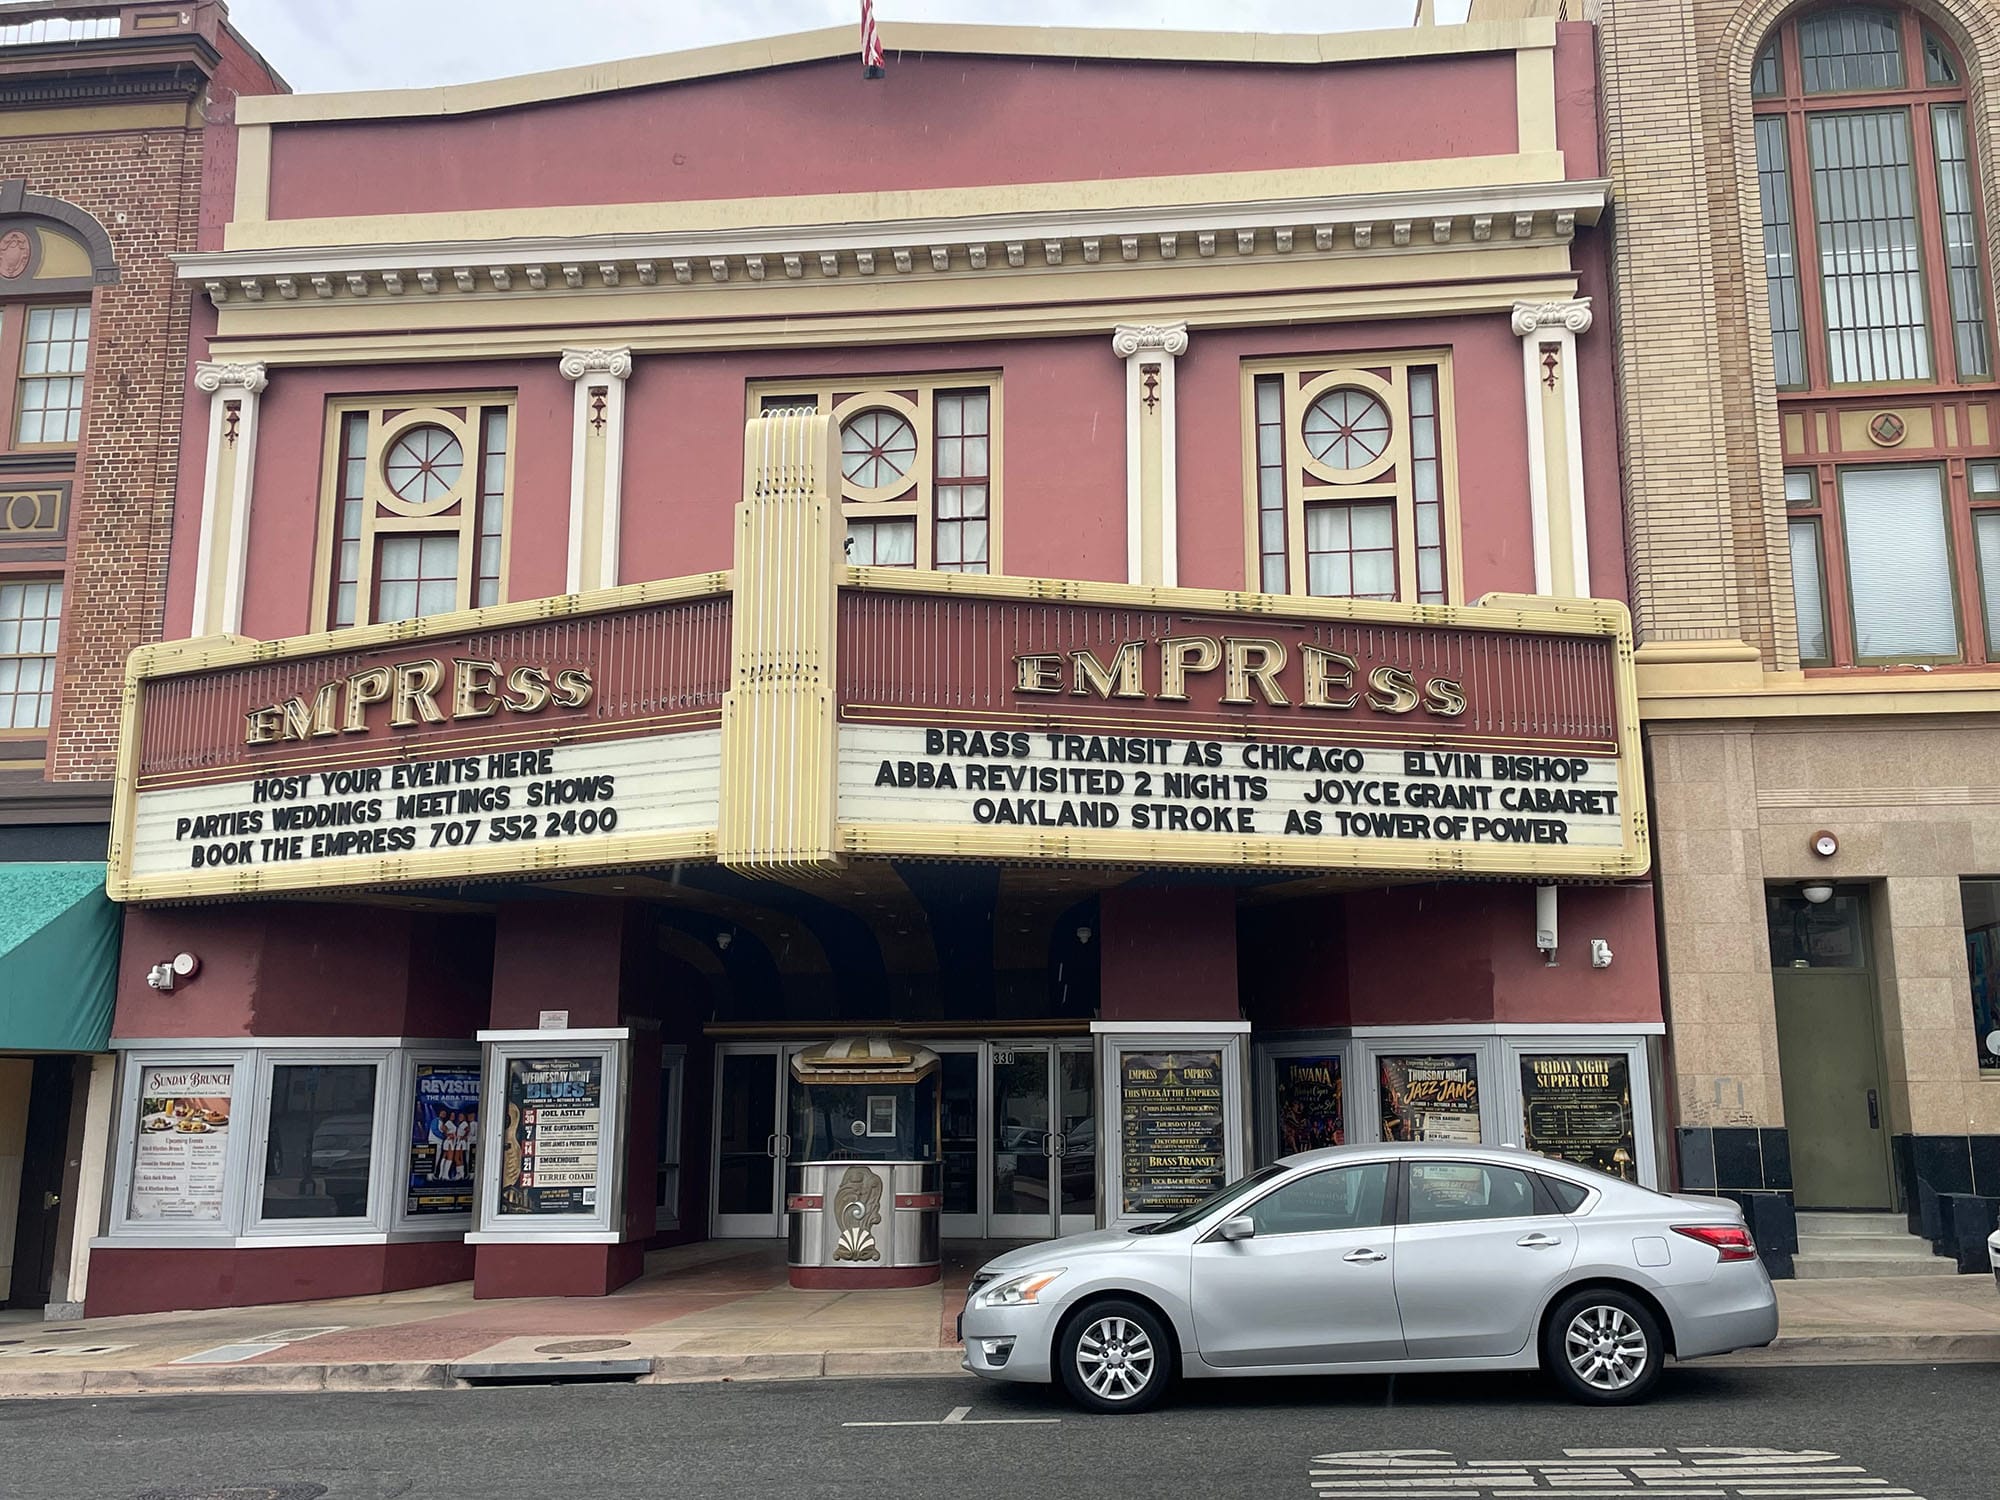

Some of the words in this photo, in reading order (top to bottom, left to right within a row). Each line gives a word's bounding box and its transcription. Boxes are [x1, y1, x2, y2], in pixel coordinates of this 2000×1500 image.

[1011, 635, 1467, 718] EMPRESS
[244, 657, 593, 744] EMPRESS
[925, 728, 1030, 758] BRASS
[1046, 733, 1172, 765] TRANSIT
[1183, 741, 1222, 767] AS
[1242, 743, 1364, 773] CHICAGO
[1404, 751, 1482, 779] ELVIN
[1492, 755, 1589, 783] BISHOP
[252, 774, 311, 803] HOST
[320, 768, 382, 796] YOUR
[391, 757, 480, 789] EVENTS
[487, 749, 553, 779] HERE
[874, 760, 958, 789] ABBA
[966, 763, 1124, 796] REVISITED
[1134, 771, 1152, 796] 2
[1164, 772, 1268, 801] NIGHTS
[1303, 778, 1400, 807] JOYCE
[1404, 783, 1492, 811] GRANT
[1499, 787, 1618, 815] CABARET
[175, 810, 263, 841] PARTIES
[272, 799, 383, 832] WEDDINGS
[396, 785, 511, 820] MEETINGS
[527, 775, 615, 807] SHOWS
[972, 797, 1119, 828] OAKLAND
[1131, 803, 1255, 833] STROKE
[1284, 809, 1323, 836] AS
[1335, 810, 1431, 840] TOWER
[1433, 815, 1469, 841] OF
[1472, 817, 1568, 844] POWER
[191, 840, 254, 868] BOOK
[260, 836, 304, 862] THE
[311, 826, 416, 858] EMPRESS
[430, 820, 481, 847] 707
[489, 814, 538, 842] 552
[544, 807, 618, 837] 2400
[993, 1052, 1014, 1064] 330
[1128, 1069, 1157, 1080] EMPRESS
[1183, 1068, 1213, 1080] EMPRESS
[1533, 1060, 1572, 1074] FRIDAY
[1575, 1060, 1609, 1074] NIGHT
[150, 1072, 190, 1090] SUNDAY
[189, 1072, 231, 1088] BRUNCH
[521, 1071, 568, 1085] WEDNESDAY
[568, 1070, 591, 1083] NIGHT
[1408, 1068, 1445, 1082] THURSDAY
[1445, 1068, 1467, 1083] NIGHT
[1537, 1074, 1580, 1088] SUPPER
[1581, 1074, 1609, 1088] CLUB
[526, 1082, 585, 1098] BLUES
[1124, 1088, 1140, 1098] THIS
[1140, 1088, 1163, 1097] WEEK
[1186, 1087, 1220, 1097] EMPRESS
[1403, 1081, 1439, 1104] JAZZ
[1437, 1080, 1477, 1102] JAMS
[524, 1115, 534, 1124] 30
[526, 1131, 532, 1139] 7
[524, 1146, 533, 1155] 14
[523, 1162, 532, 1171] 21
[1149, 1156, 1177, 1167] BRASS
[1177, 1156, 1216, 1167] TRANSIT
